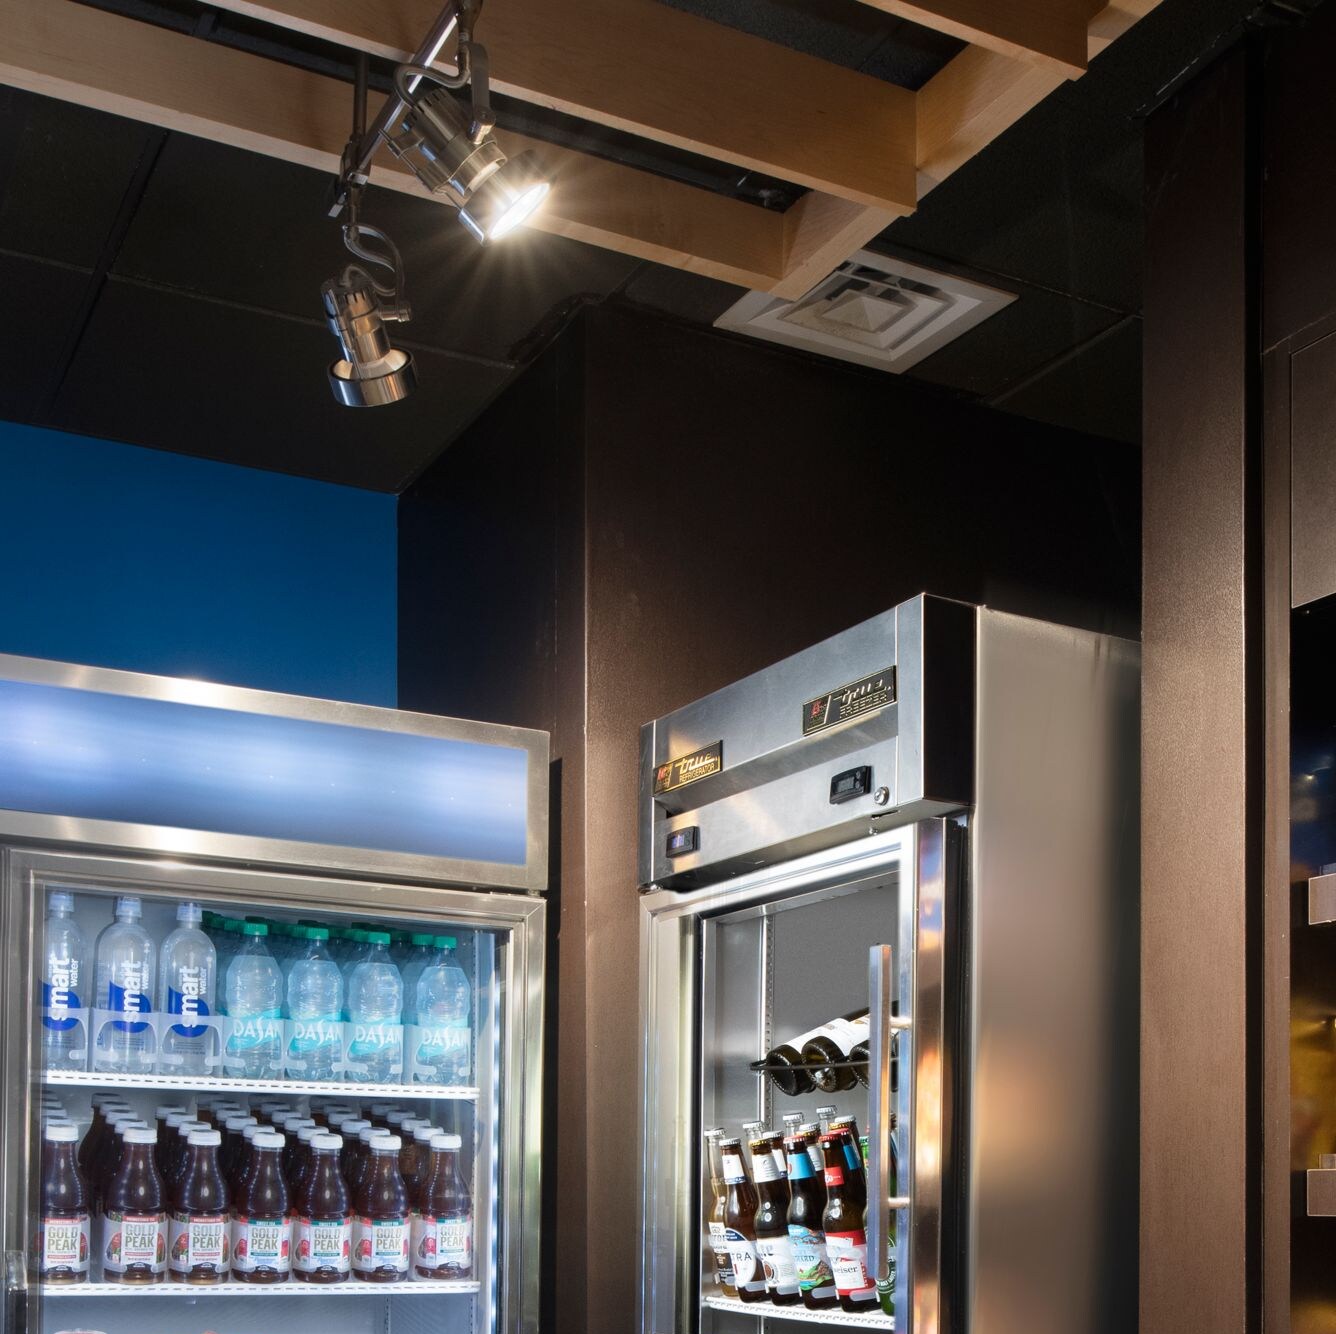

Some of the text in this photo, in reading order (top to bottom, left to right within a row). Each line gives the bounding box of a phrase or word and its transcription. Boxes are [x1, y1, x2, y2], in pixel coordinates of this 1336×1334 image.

[680, 763, 715, 783] REFRIGERATOR
[49, 953, 70, 1021] smart
[121, 960, 141, 1023] smart
[179, 966, 200, 1028] smart
[48, 1226, 78, 1239] GOLD
[125, 1224, 155, 1236] GOLD
[193, 1225, 220, 1236] GOLD
[252, 1227, 279, 1239] GOLD
[314, 1227, 340, 1239] GOLD
[376, 1227, 401, 1238] GOLD
[441, 1225, 464, 1237] GOLD
[47, 1239, 77, 1250] PEAK
[125, 1236, 154, 1248] PEAK
[192, 1236, 220, 1248] PEAK
[250, 1239, 278, 1250] PEAK
[314, 1239, 339, 1250] PEAK
[376, 1238, 400, 1249] PEAK
[440, 1236, 463, 1247] PEAK
